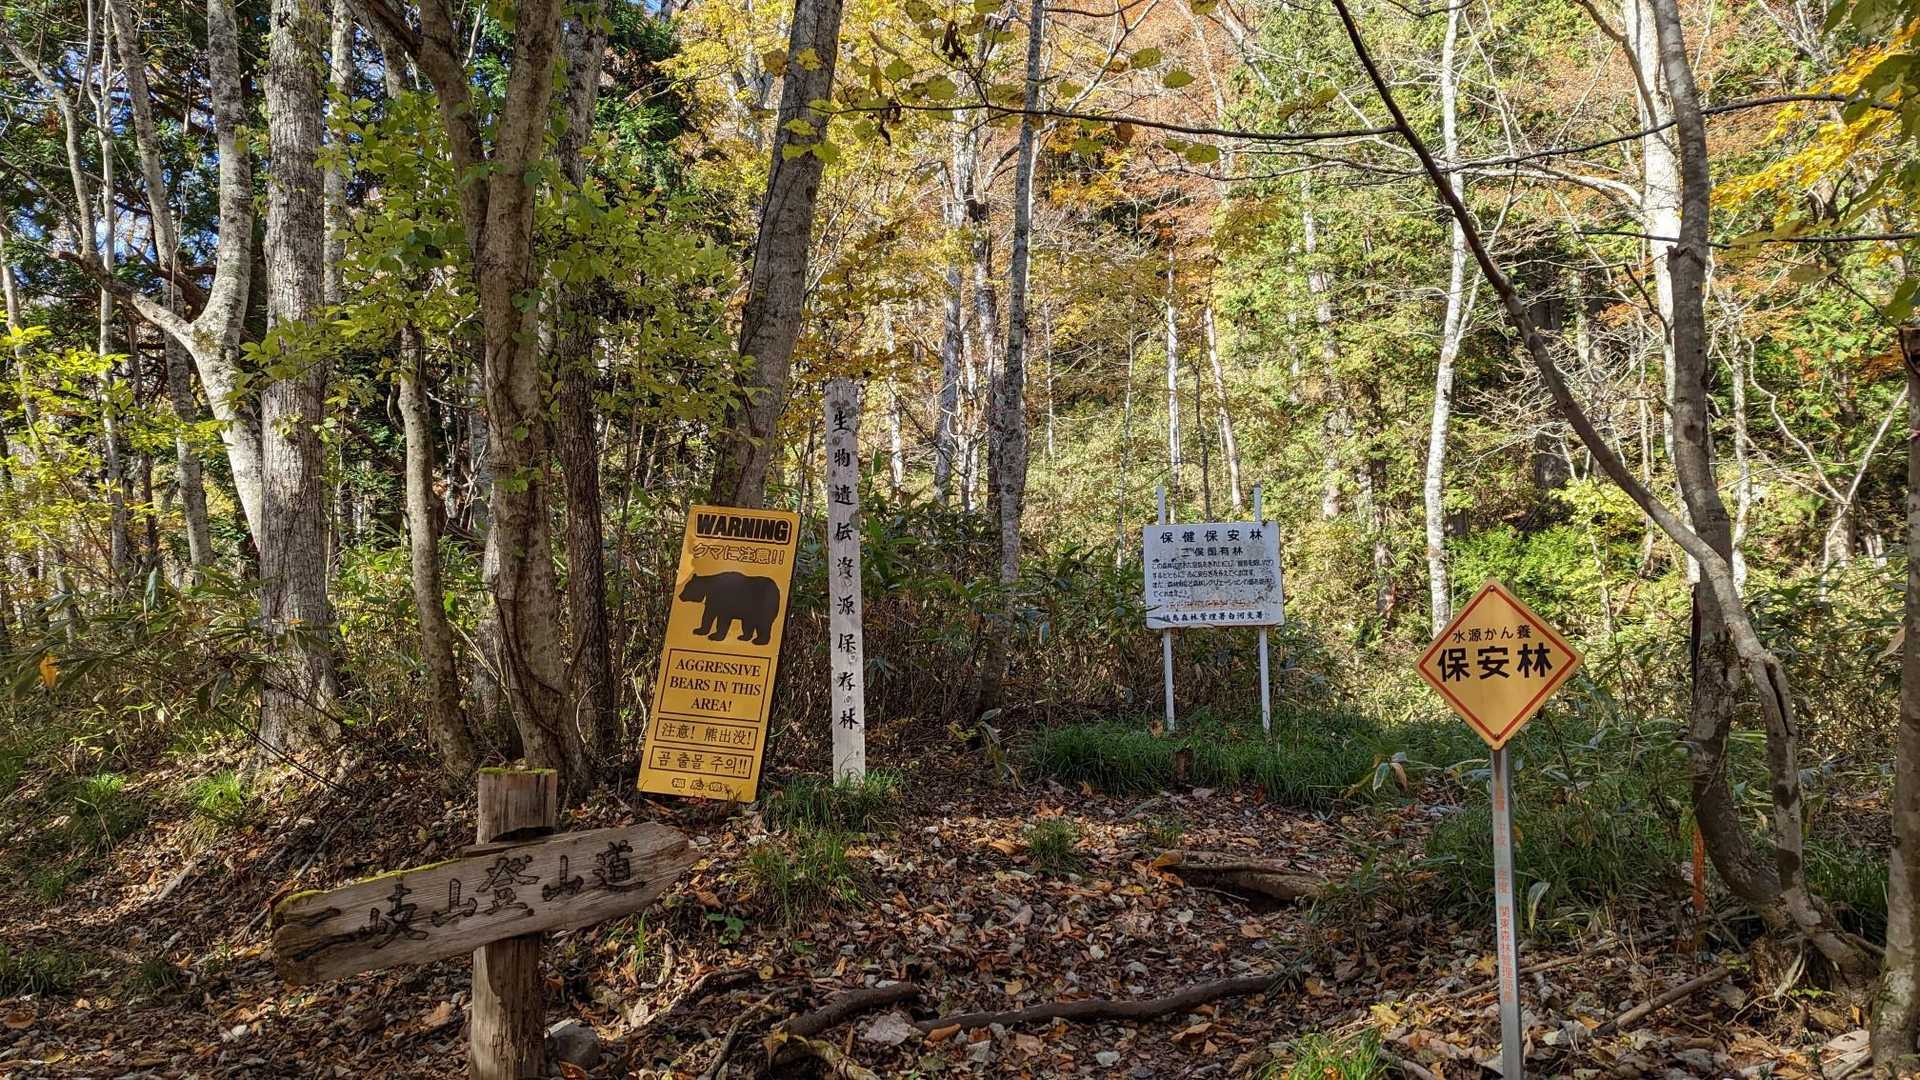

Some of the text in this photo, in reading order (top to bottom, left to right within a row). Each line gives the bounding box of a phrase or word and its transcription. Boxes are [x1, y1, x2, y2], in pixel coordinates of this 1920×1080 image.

[696, 513, 790, 543] WARNING
[1160, 528, 1263, 543] 保健保安林
[1453, 624, 1531, 643] 水源かん養
[675, 658, 761, 677] AGGRESSIVE
[1437, 642, 1553, 682] 保安林
[670, 676, 761, 696] BEARS IN THIS
[691, 698, 733, 712] AREA!
[657, 751, 747, 774] 곰 출몰 주의!!
